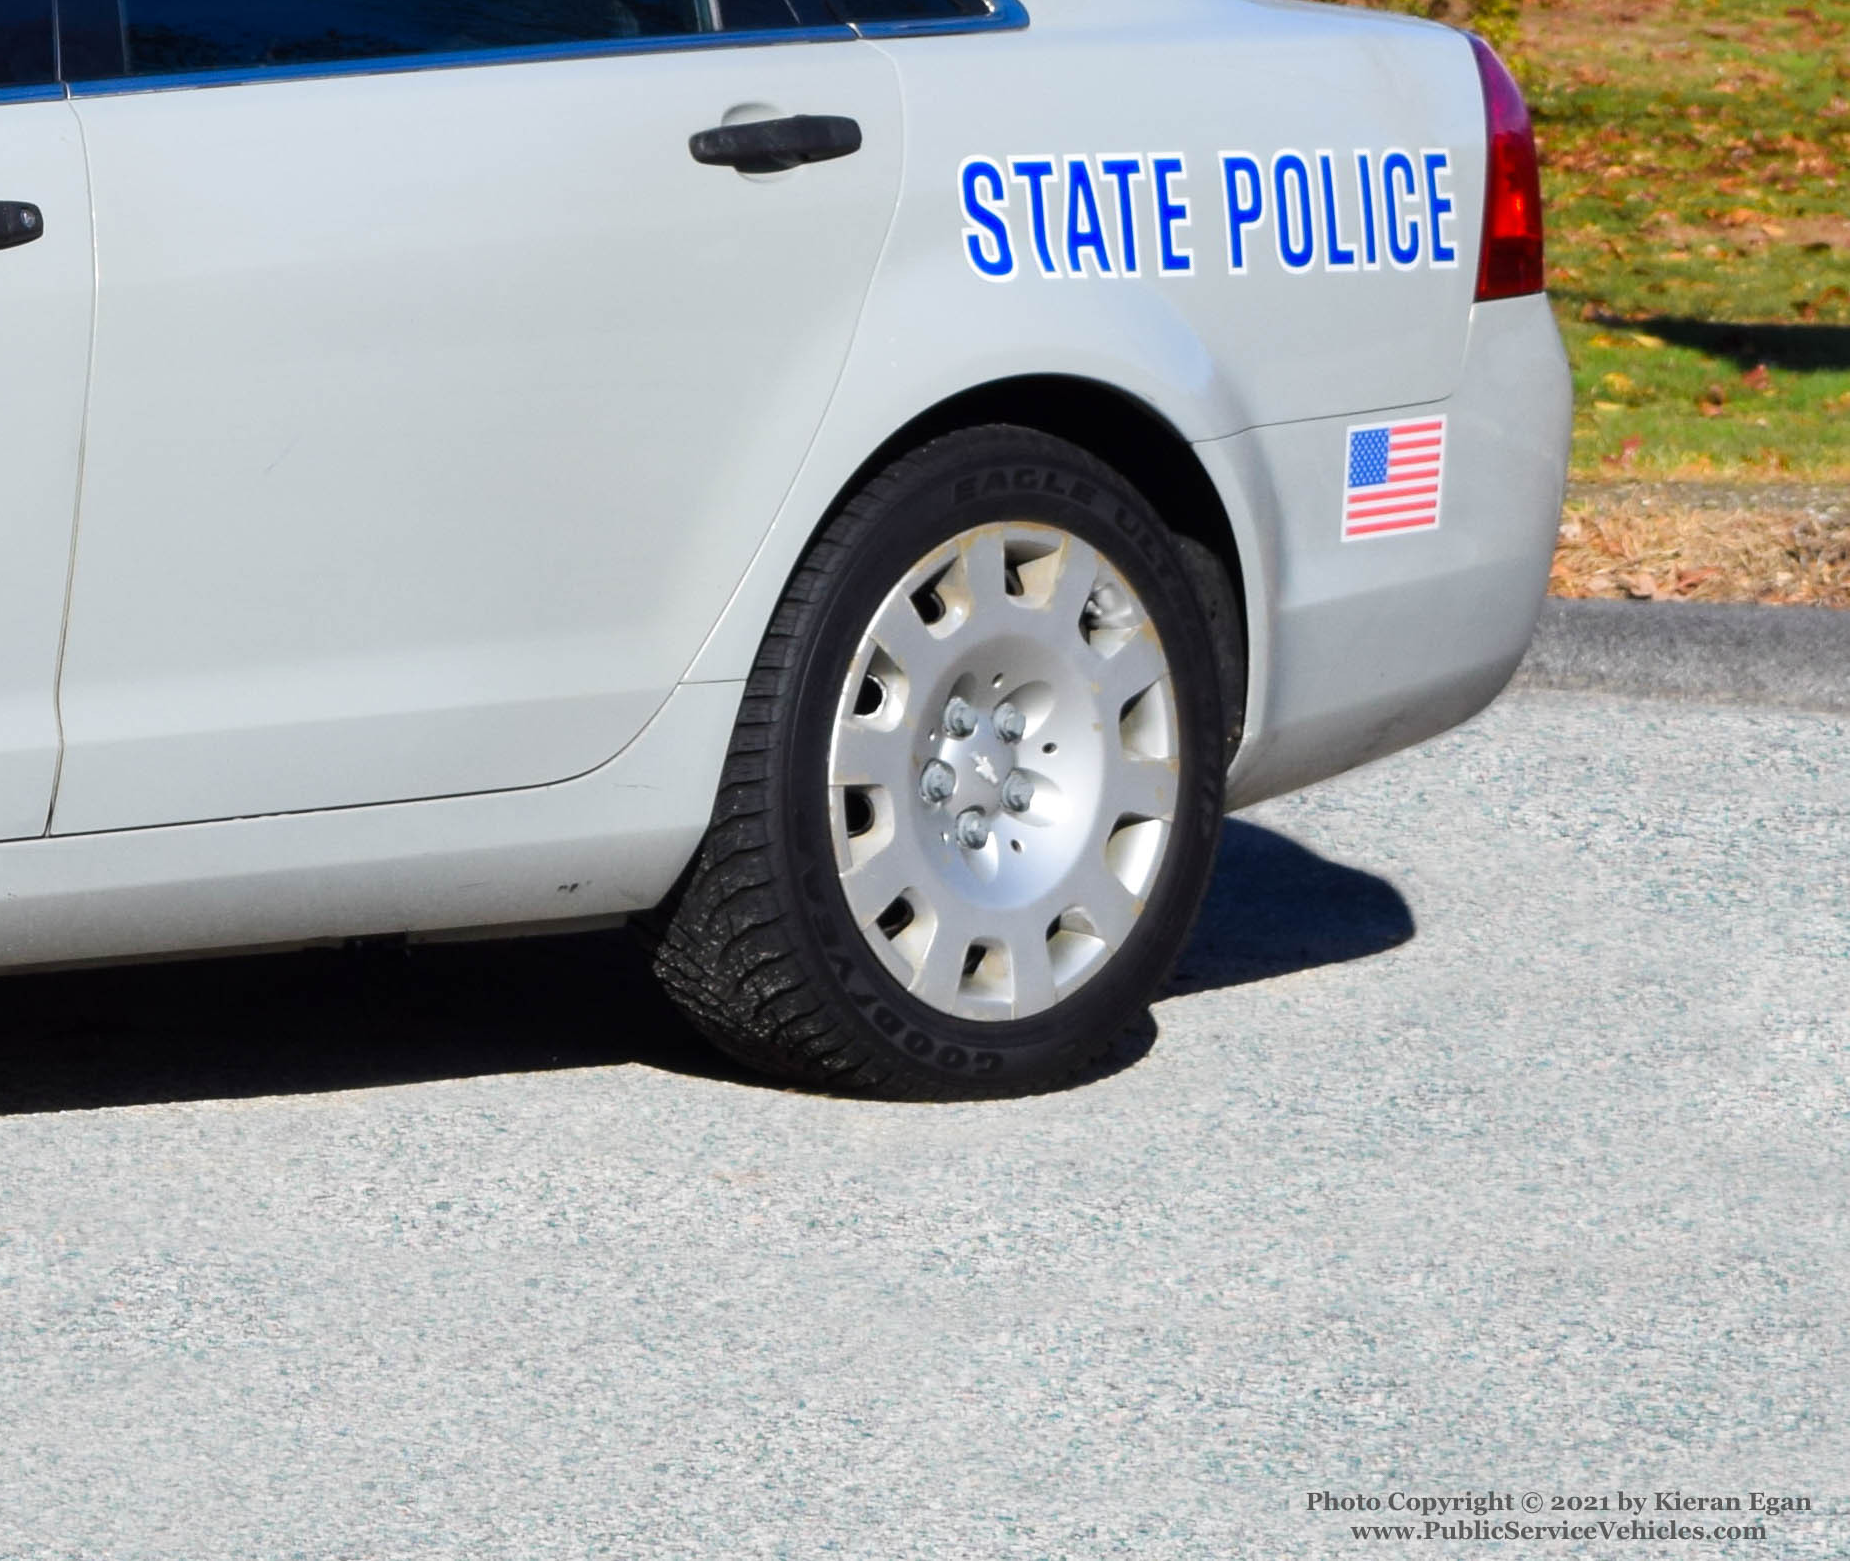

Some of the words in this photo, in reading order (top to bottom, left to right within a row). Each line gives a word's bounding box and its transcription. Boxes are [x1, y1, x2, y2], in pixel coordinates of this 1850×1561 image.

[957, 150, 1195, 283] STATE
[1218, 147, 1458, 275] POLICE
[952, 468, 1101, 505] EAGLE
